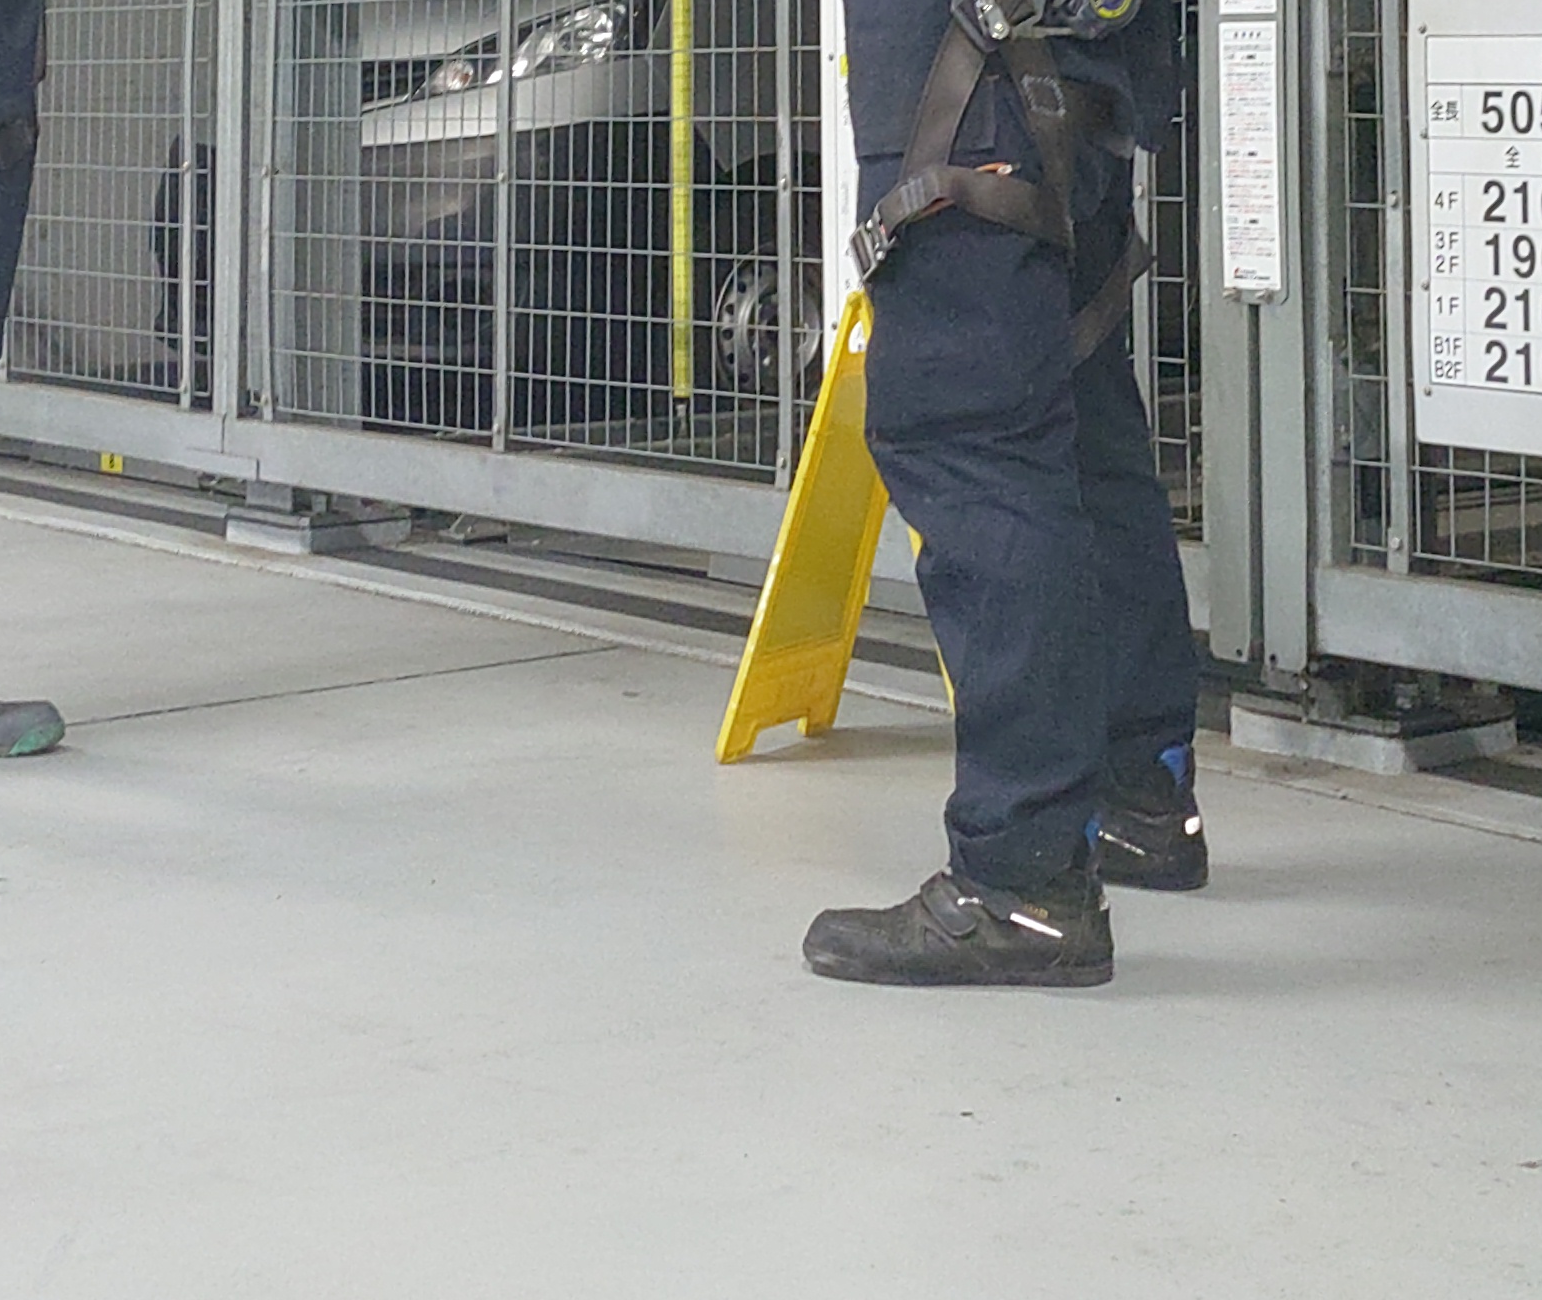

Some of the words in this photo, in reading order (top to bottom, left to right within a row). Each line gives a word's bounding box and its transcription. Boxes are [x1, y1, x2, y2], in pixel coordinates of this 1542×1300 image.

[1430, 99, 1459, 122] 全長
[1434, 191, 1459, 210] 4F
[1435, 231, 1459, 250] 3F
[1435, 254, 1459, 274] 2F
[1436, 296, 1459, 315] 1F
[1434, 336, 1462, 356] B1F
[1434, 360, 1463, 379] B2F
